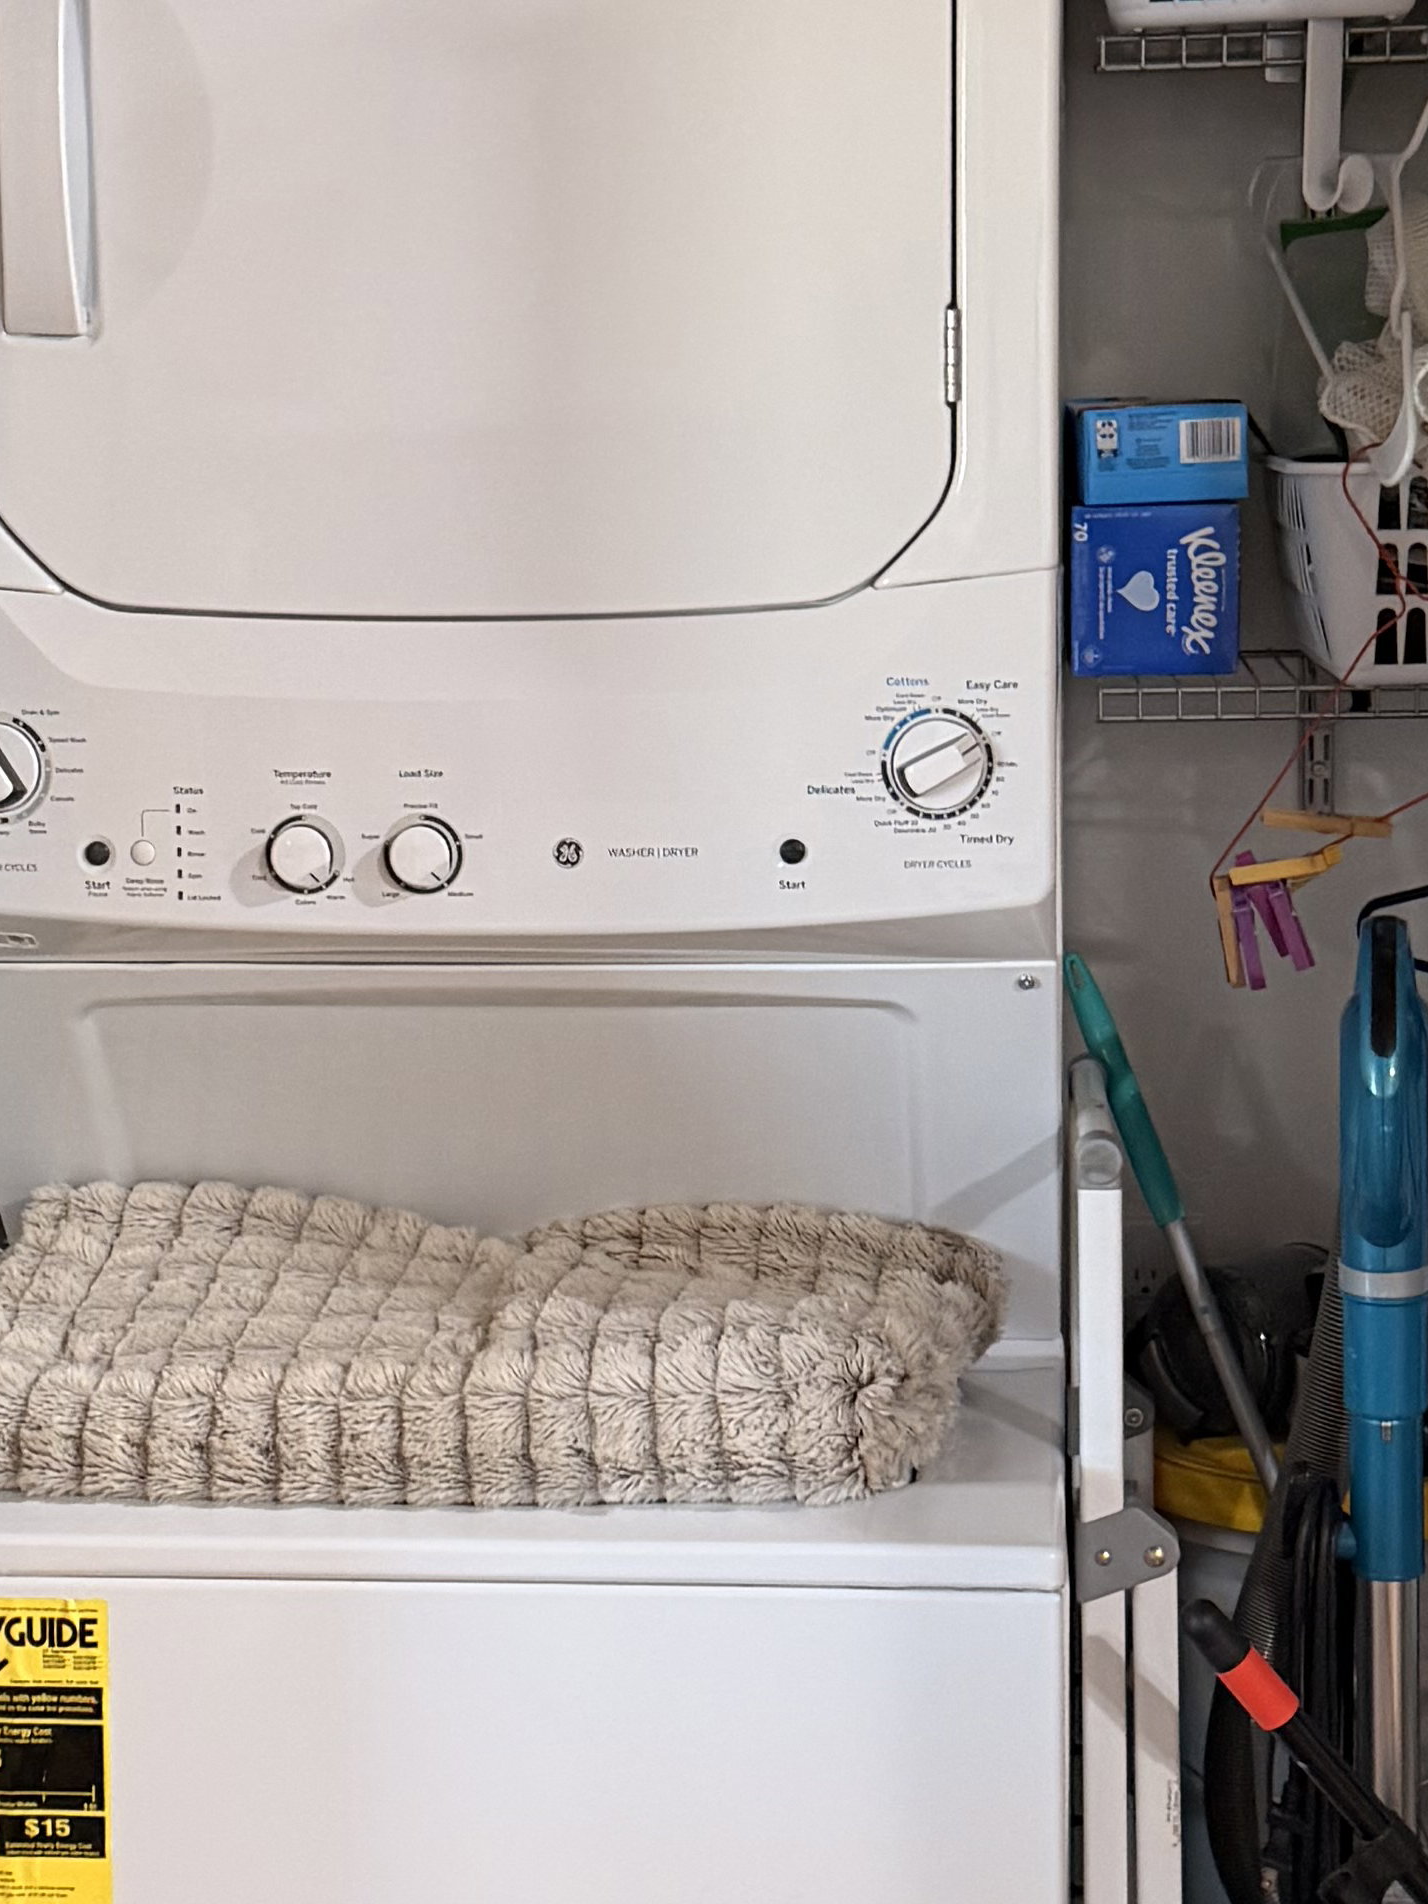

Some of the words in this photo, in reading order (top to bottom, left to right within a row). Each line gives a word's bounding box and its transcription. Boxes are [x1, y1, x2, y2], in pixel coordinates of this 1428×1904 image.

[1073, 522, 1088, 542] 70
[1166, 548, 1178, 598] trusted
[1179, 526, 1226, 655] Kleenex
[1166, 599, 1176, 636] care
[886, 677, 929, 687] Cottons
[966, 680, 991, 691] Easy
[994, 680, 1018, 689] Care
[274, 770, 332, 778] Temperature
[173, 786, 204, 794] Status
[807, 785, 855, 794] Delicates
[960, 834, 993, 844] Timed
[996, 834, 1014, 845] Dry
[608, 848, 655, 857] WASHER
[662, 848, 699, 857] DRYER
[4, 864, 37, 872] CYCLES
[937, 860, 972, 869] CYCLES
[85, 881, 110, 889] Start
[779, 880, 806, 890] Start
[12, 1693, 29, 1703] with
[31, 1693, 57, 1704] yellow
[3, 1727, 31, 1737] Energy
[33, 1727, 52, 1737] Cost
[24, 1818, 71, 1838] $15
